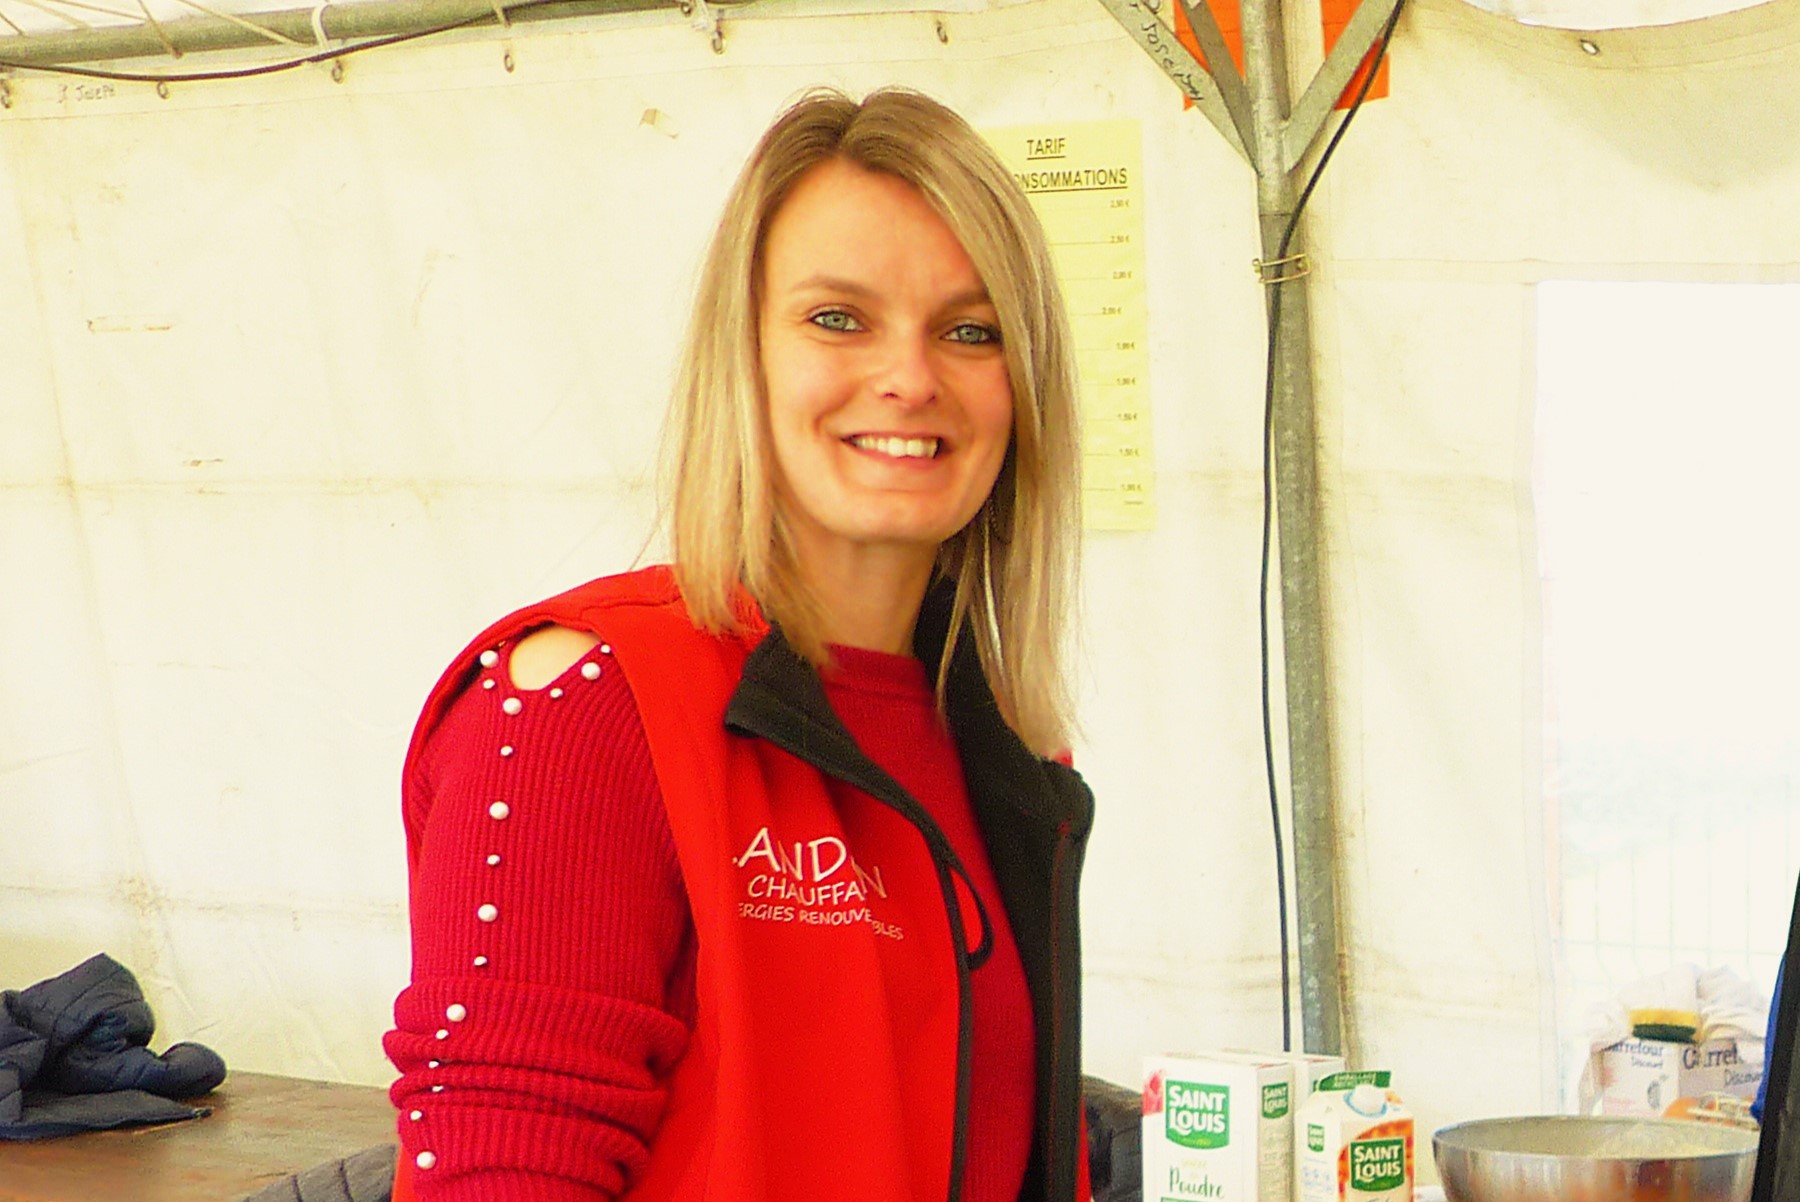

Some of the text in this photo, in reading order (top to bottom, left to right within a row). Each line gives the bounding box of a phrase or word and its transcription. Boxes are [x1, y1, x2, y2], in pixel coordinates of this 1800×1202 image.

[1026, 137, 1066, 156] TARIF
[1014, 167, 1128, 190] NSOMMATIONS
[747, 874, 865, 906] CHAUFFA
[738, 902, 904, 940] ERGIES RENOUVEBLES
[1611, 1040, 1664, 1057] arrefour
[1169, 1085, 1226, 1112] SAINT
[1169, 1108, 1227, 1136] LOUIS
[1354, 1145, 1400, 1164] SAINT
[1169, 1165, 1225, 1199] Poudre
[1354, 1161, 1401, 1183] LOUIS
